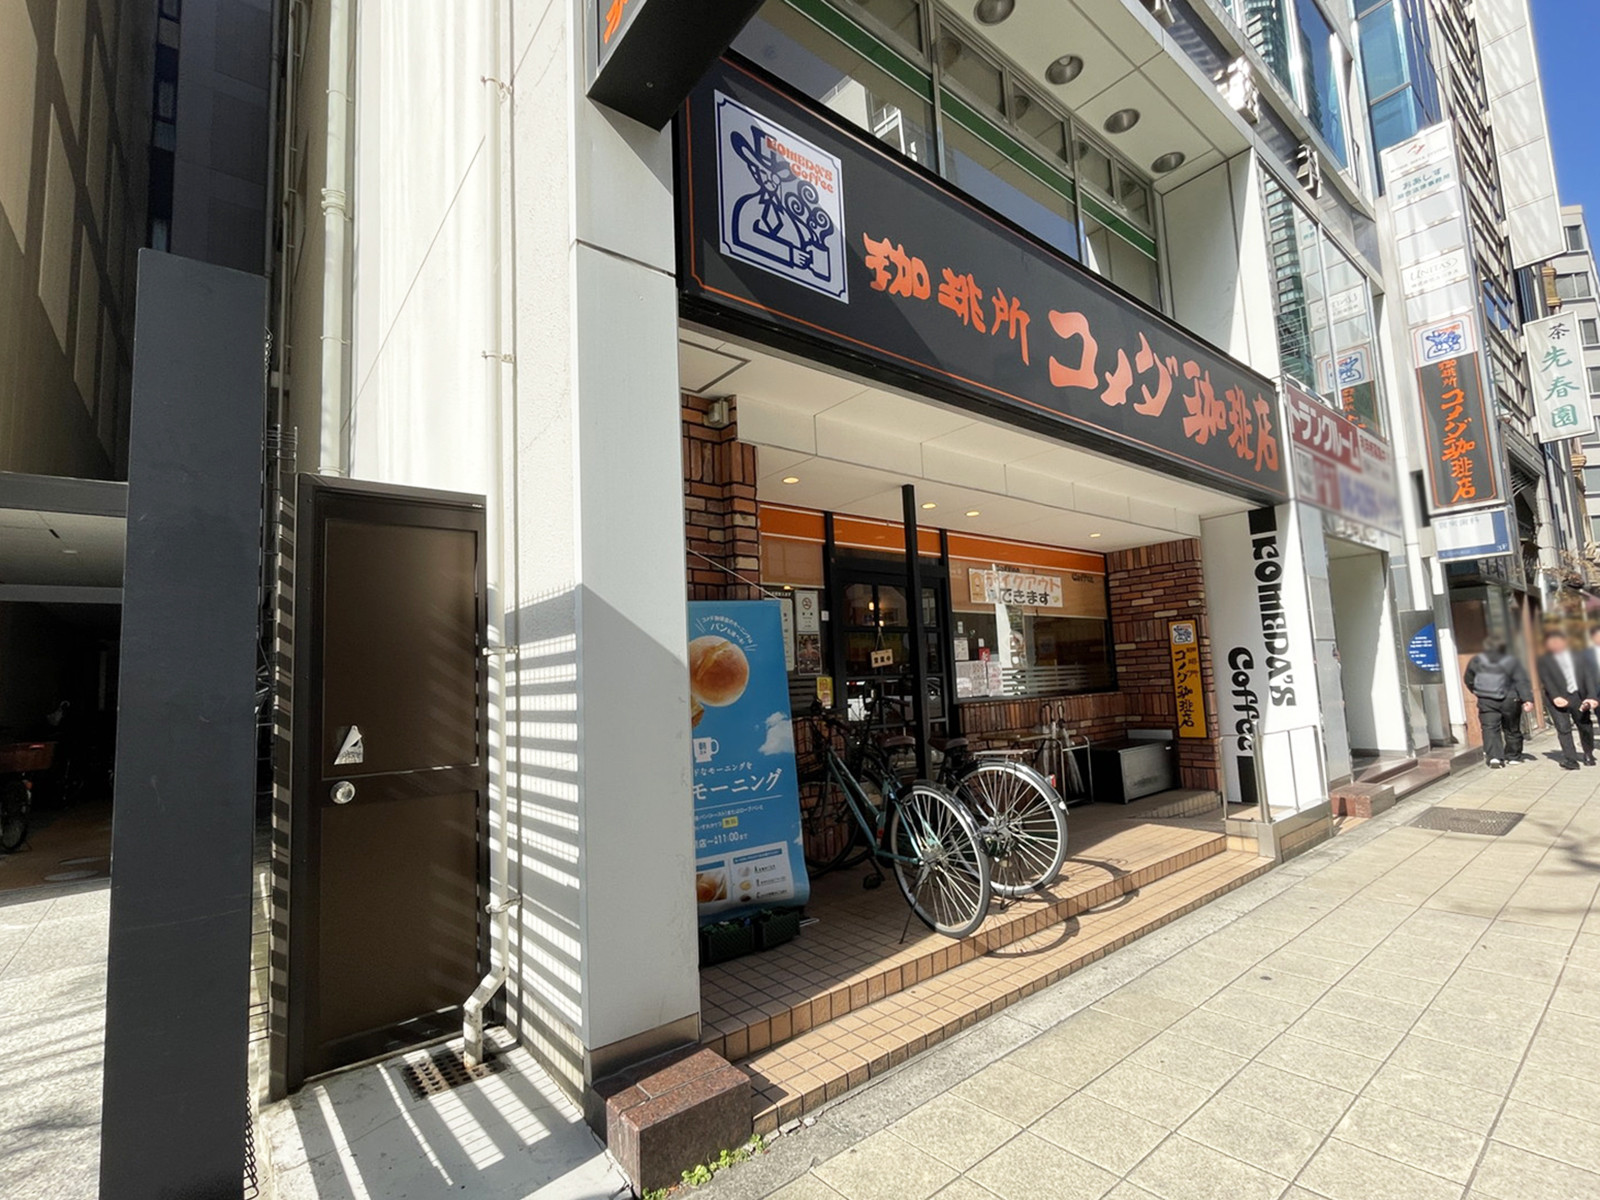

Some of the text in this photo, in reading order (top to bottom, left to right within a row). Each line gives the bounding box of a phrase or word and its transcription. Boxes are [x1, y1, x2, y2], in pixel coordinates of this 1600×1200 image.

[790, 163, 834, 194] Coffee
[1048, 309, 1279, 473] コメダ珈琲店
[1000, 588, 1050, 605] できます
[1251, 535, 1297, 708] KOMEDA'S
[1227, 646, 1261, 753] Coffee
[692, 768, 782, 800] モーニング
